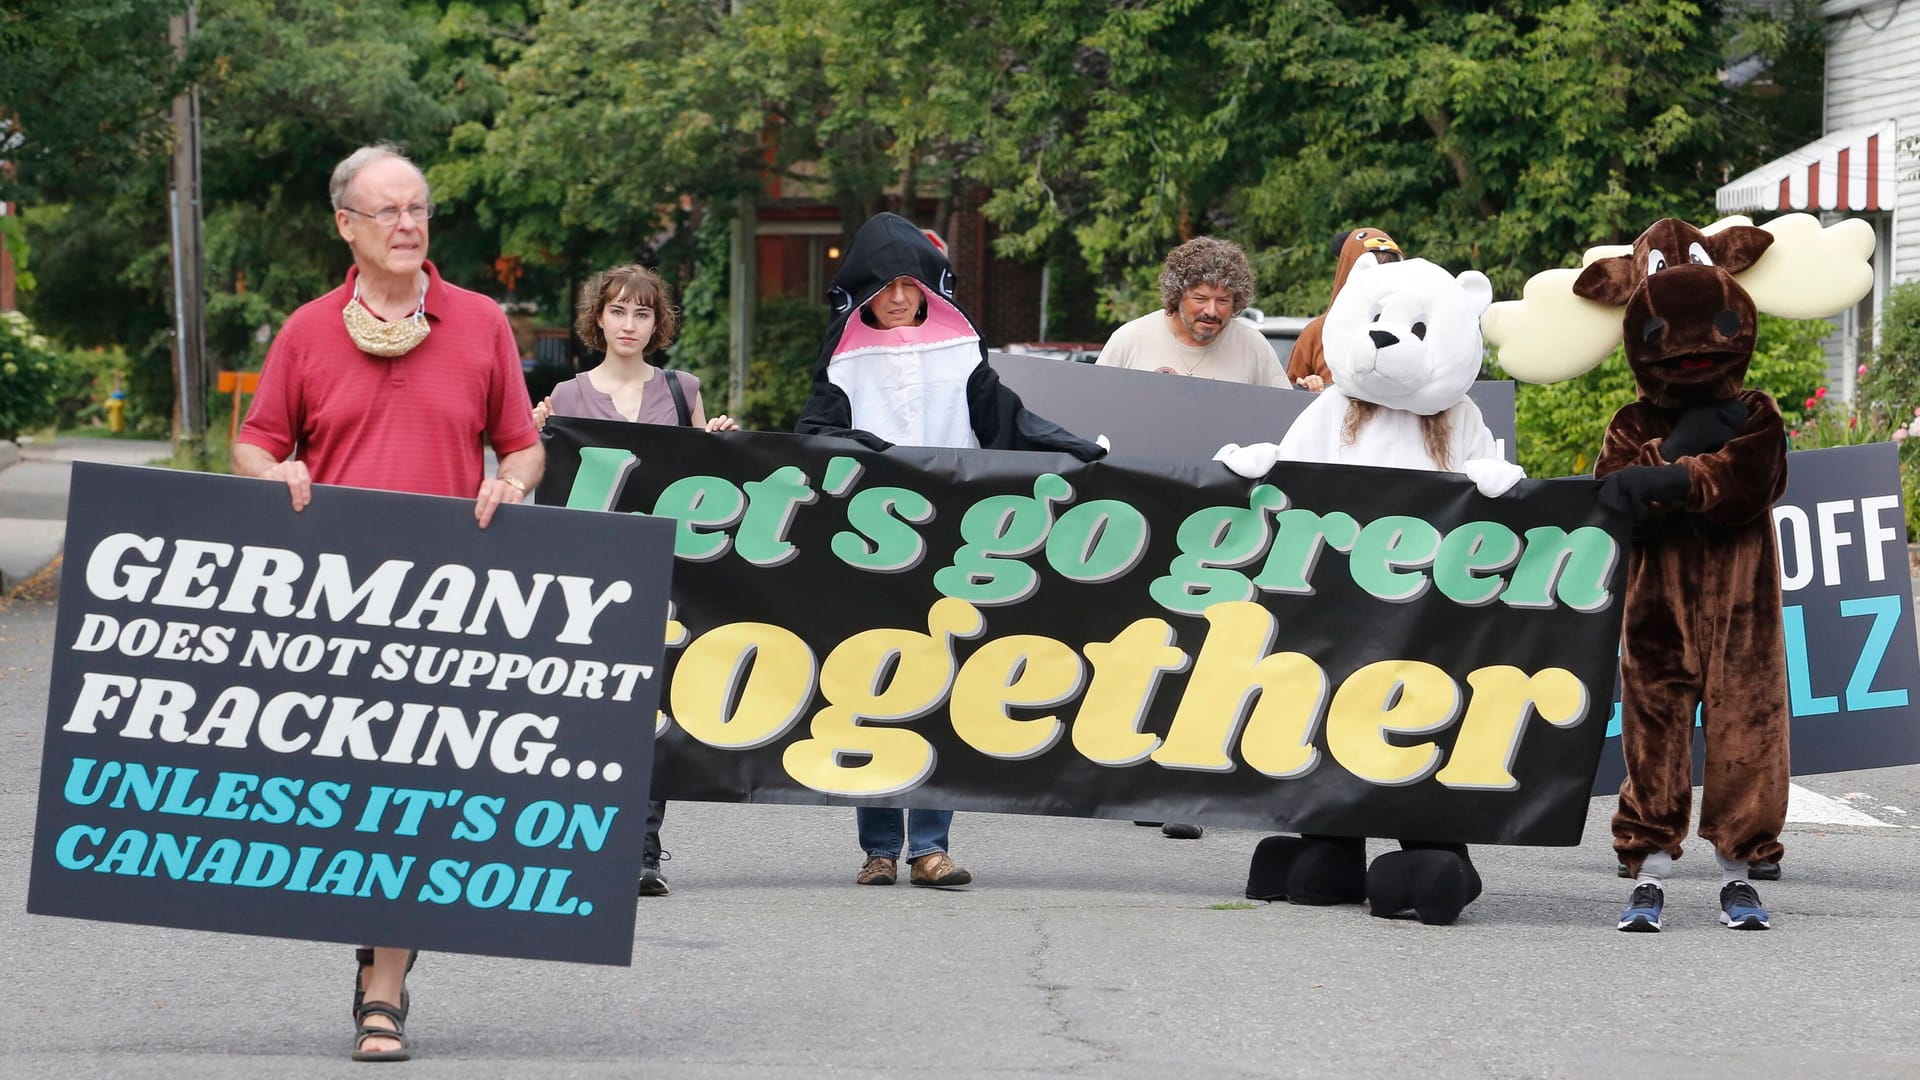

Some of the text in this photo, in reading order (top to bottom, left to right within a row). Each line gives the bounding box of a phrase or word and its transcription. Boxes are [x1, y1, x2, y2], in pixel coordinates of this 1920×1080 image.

[85, 532, 633, 645] GERMANY
[933, 472, 1150, 606] go
[1149, 484, 1618, 615] green
[1771, 494, 1900, 591] OFF
[71, 613, 654, 702] DOES NOT SUPPORT
[656, 597, 1587, 796] ogether
[62, 672, 623, 782] FRACKING...
[64, 757, 619, 852] UNLESS IT'S ON
[55, 824, 594, 916] CANADIAN SOIL.
